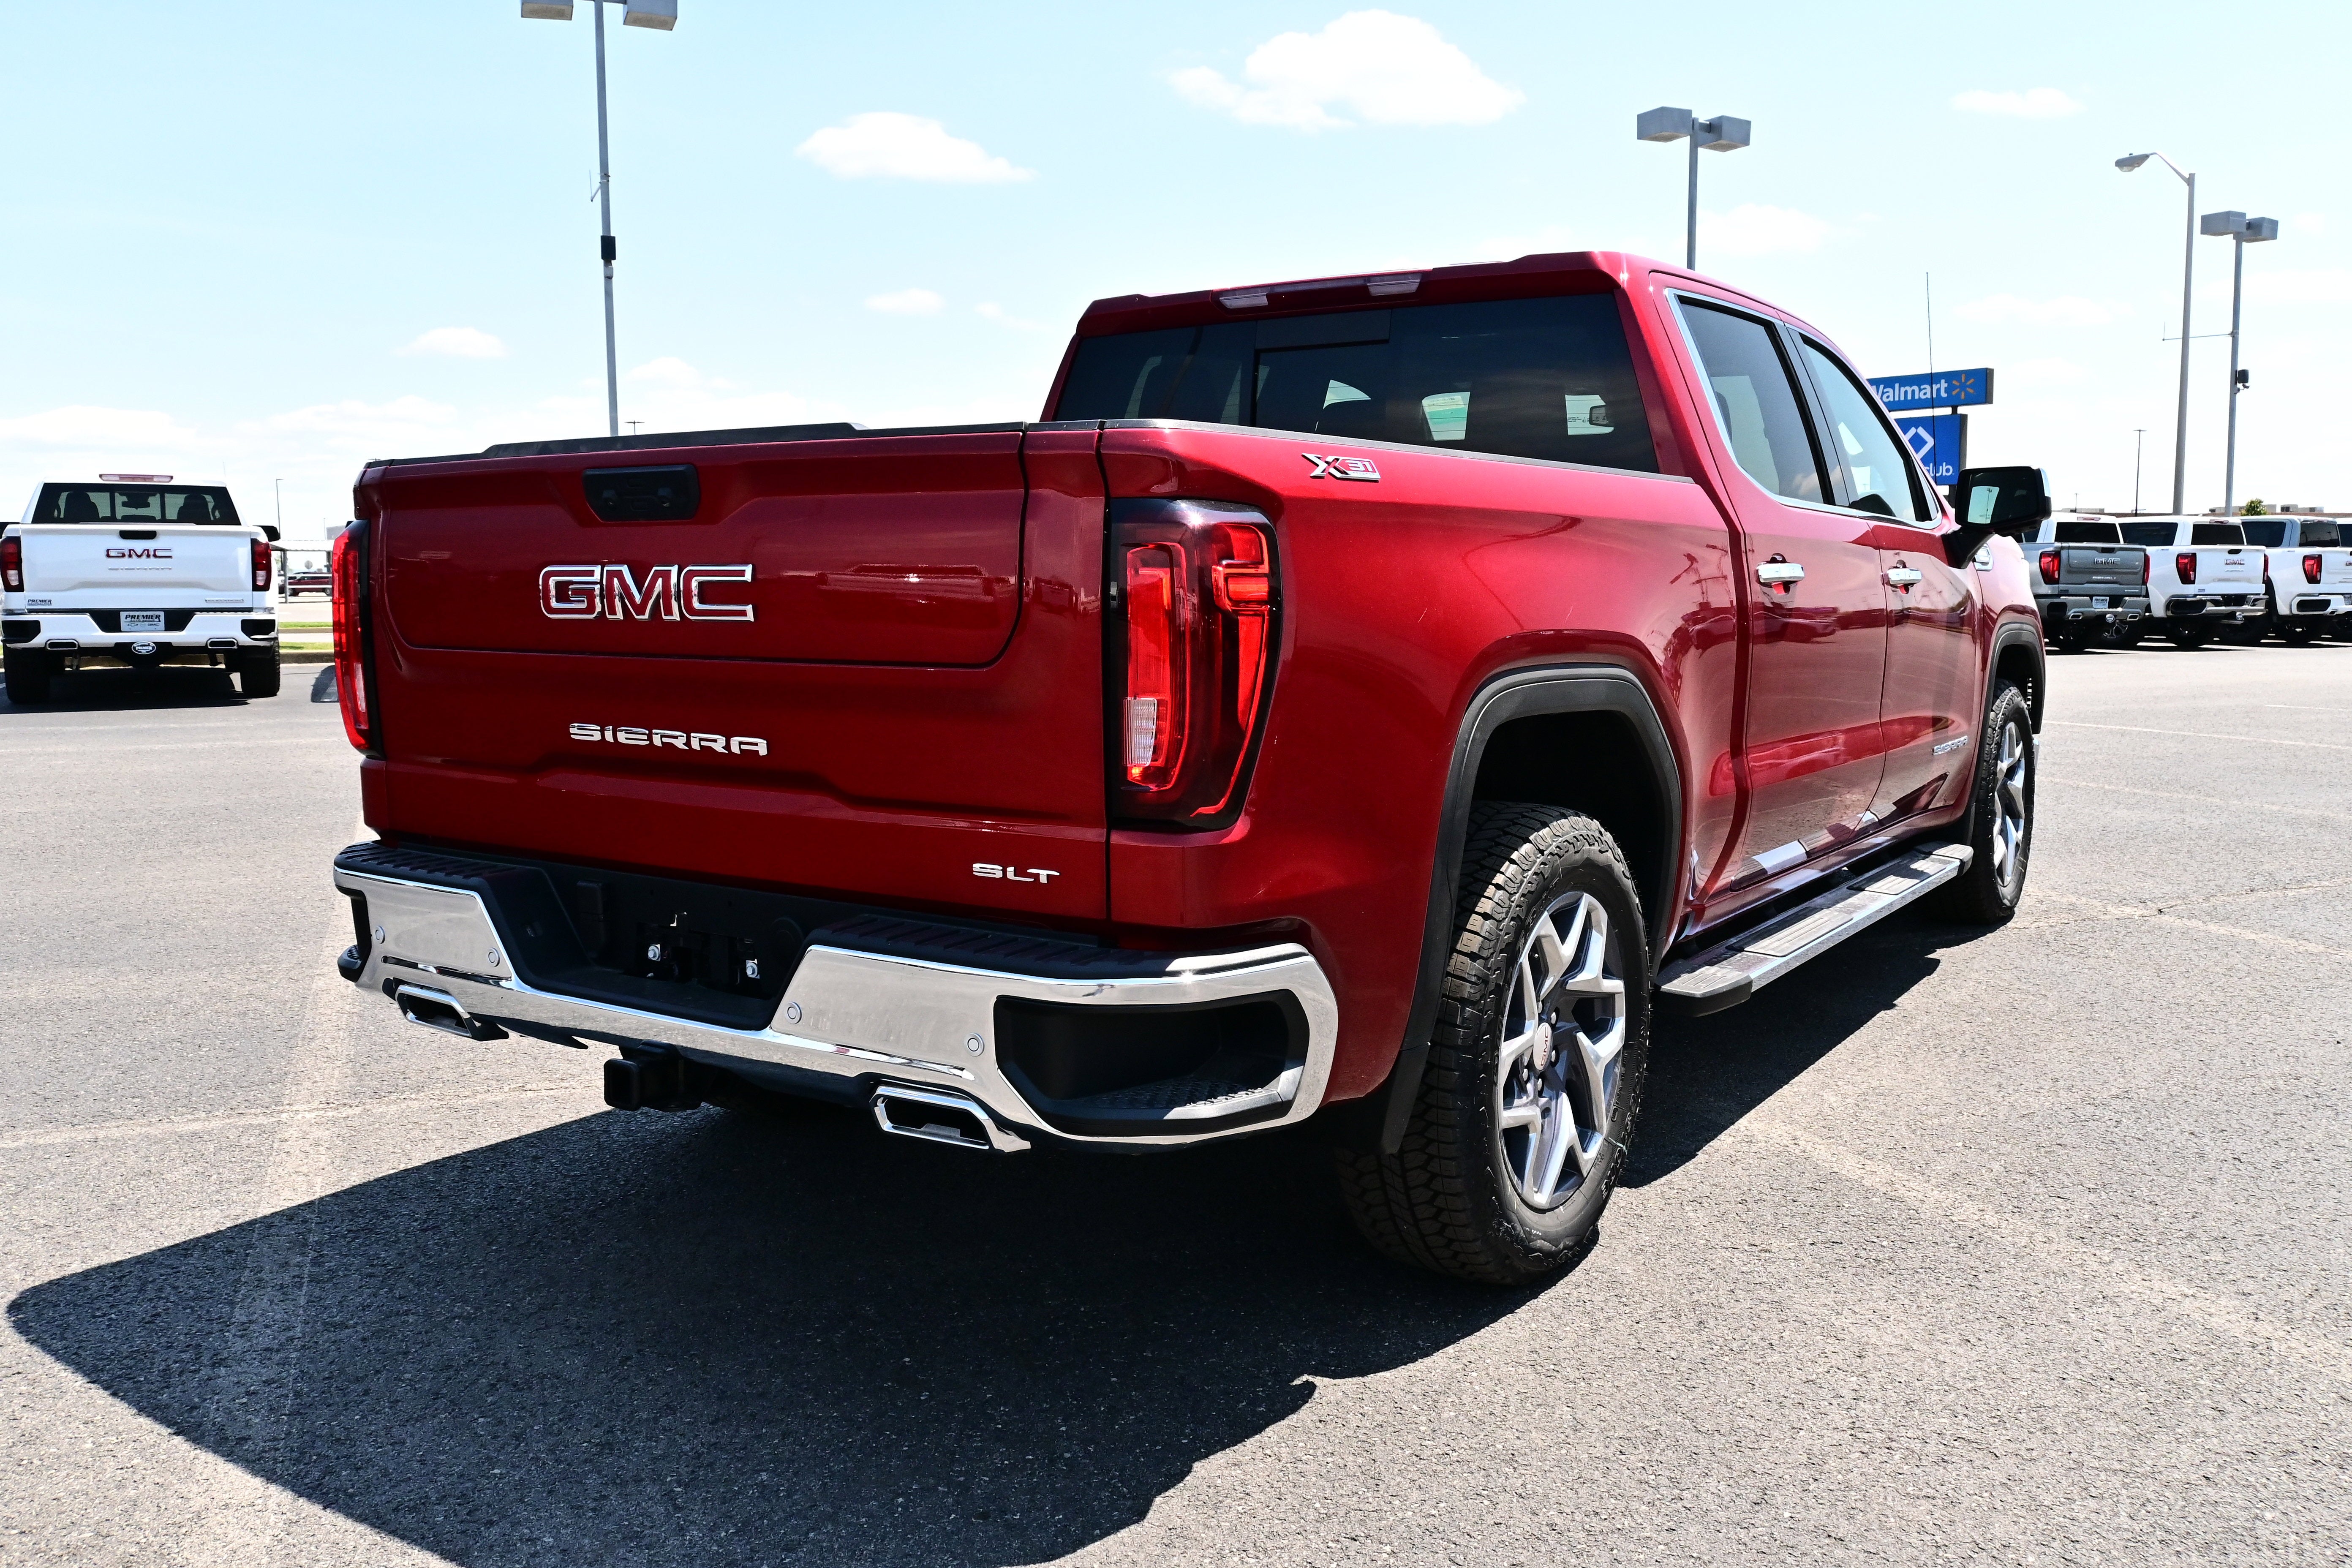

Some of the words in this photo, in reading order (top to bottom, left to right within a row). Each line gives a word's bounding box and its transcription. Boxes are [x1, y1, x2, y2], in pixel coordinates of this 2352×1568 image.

[1301, 453, 1380, 480] X31
[1926, 462, 1953, 476] lub
[106, 548, 172, 558] GMC
[539, 564, 754, 622] GMC
[569, 723, 768, 756] SIERRA
[973, 863, 1059, 883] SLT
[1541, 1026, 1549, 1066] GMC
